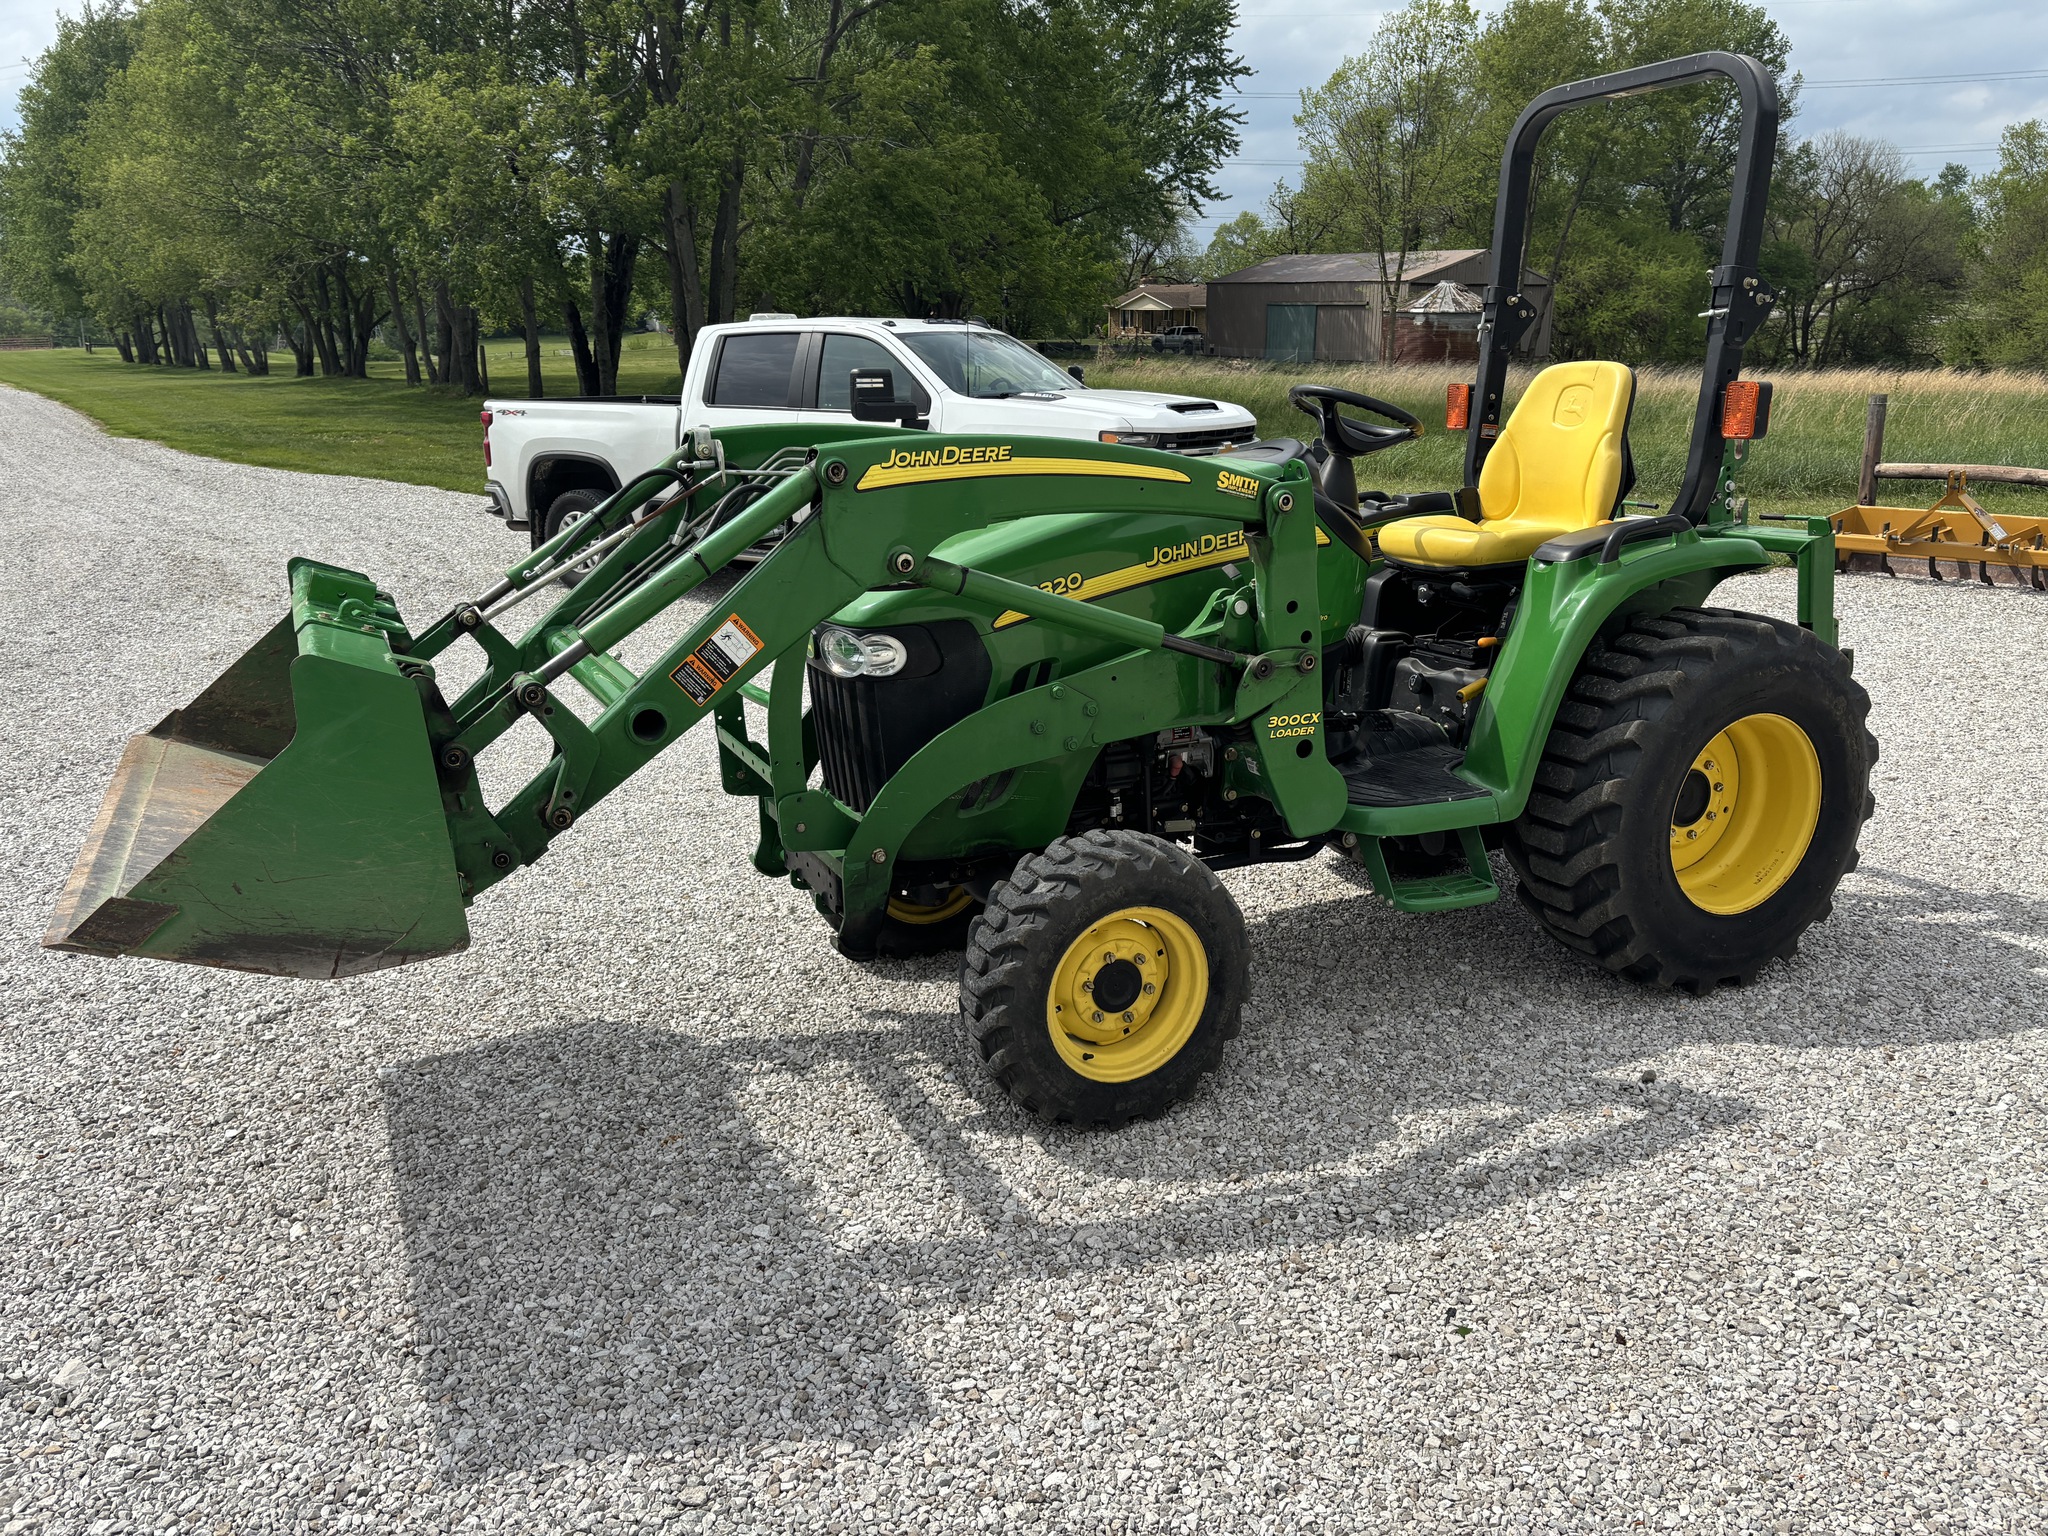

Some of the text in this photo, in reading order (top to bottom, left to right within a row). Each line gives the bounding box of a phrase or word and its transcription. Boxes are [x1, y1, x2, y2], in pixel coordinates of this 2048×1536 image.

[880, 445, 1012, 468] JOHN DEERE
[1216, 470, 1260, 491] SMITH
[1145, 540, 1199, 567] JOHN
[1031, 571, 1083, 595] 320
[738, 622, 760, 646] WARNING
[695, 663, 717, 687] WARNING
[1267, 711, 1322, 728] 300CX
[1269, 726, 1315, 739] LOADER
